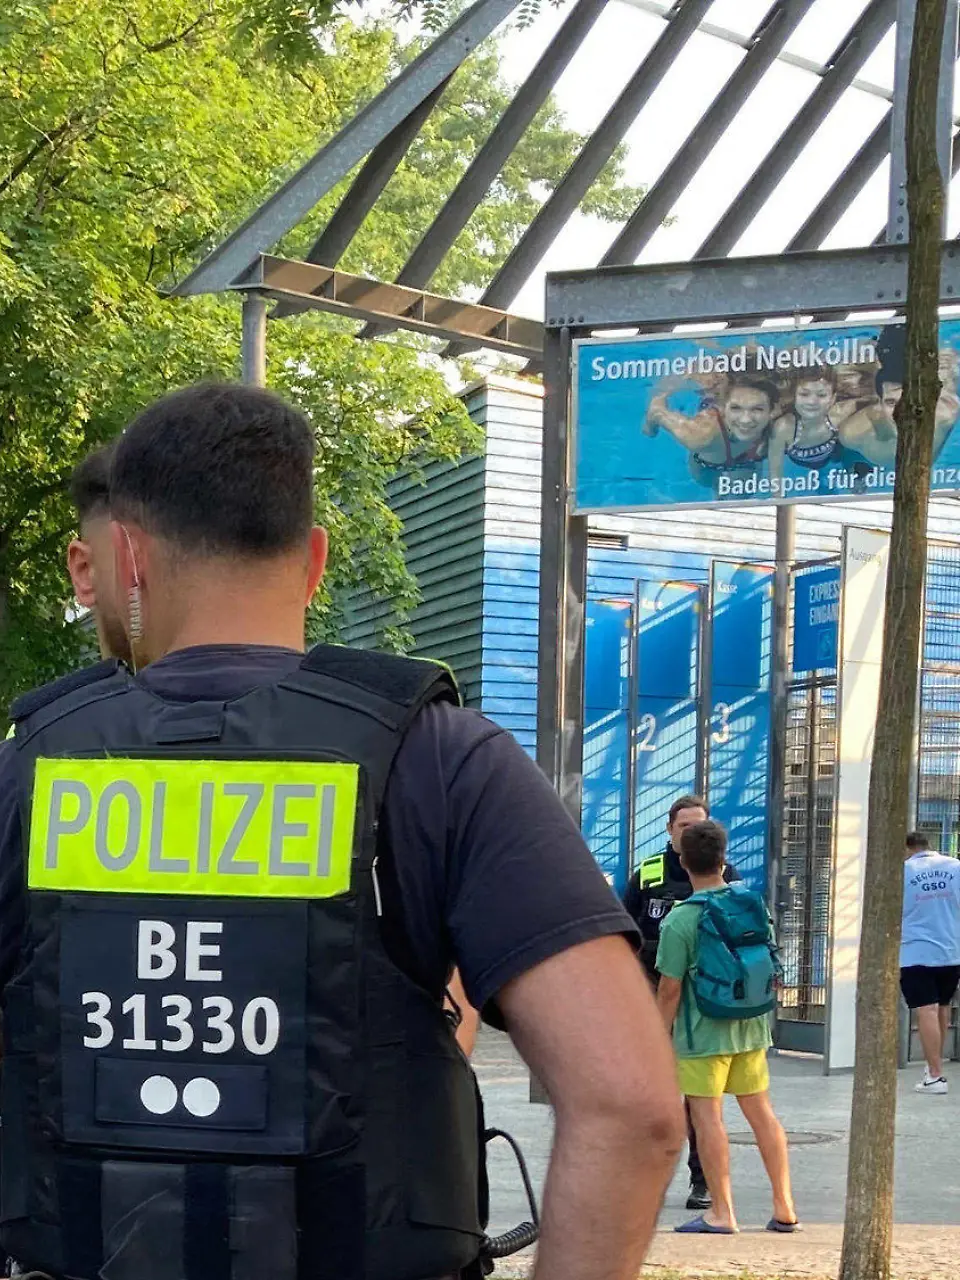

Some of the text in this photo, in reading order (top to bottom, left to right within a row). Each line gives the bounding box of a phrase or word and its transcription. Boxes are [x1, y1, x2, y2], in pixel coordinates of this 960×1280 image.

[591, 338, 876, 382] Sommerbad Neukölln
[719, 466, 896, 498] Badespaß für die
[809, 602, 839, 626] EINGAN
[637, 713, 657, 752] 2
[711, 702, 730, 744] 3
[44, 778, 336, 878] POLIZEI
[909, 869, 955, 886] SECURITY
[921, 881, 947, 892] GSO
[137, 919, 224, 982] BE
[80, 991, 280, 1056] 31330
